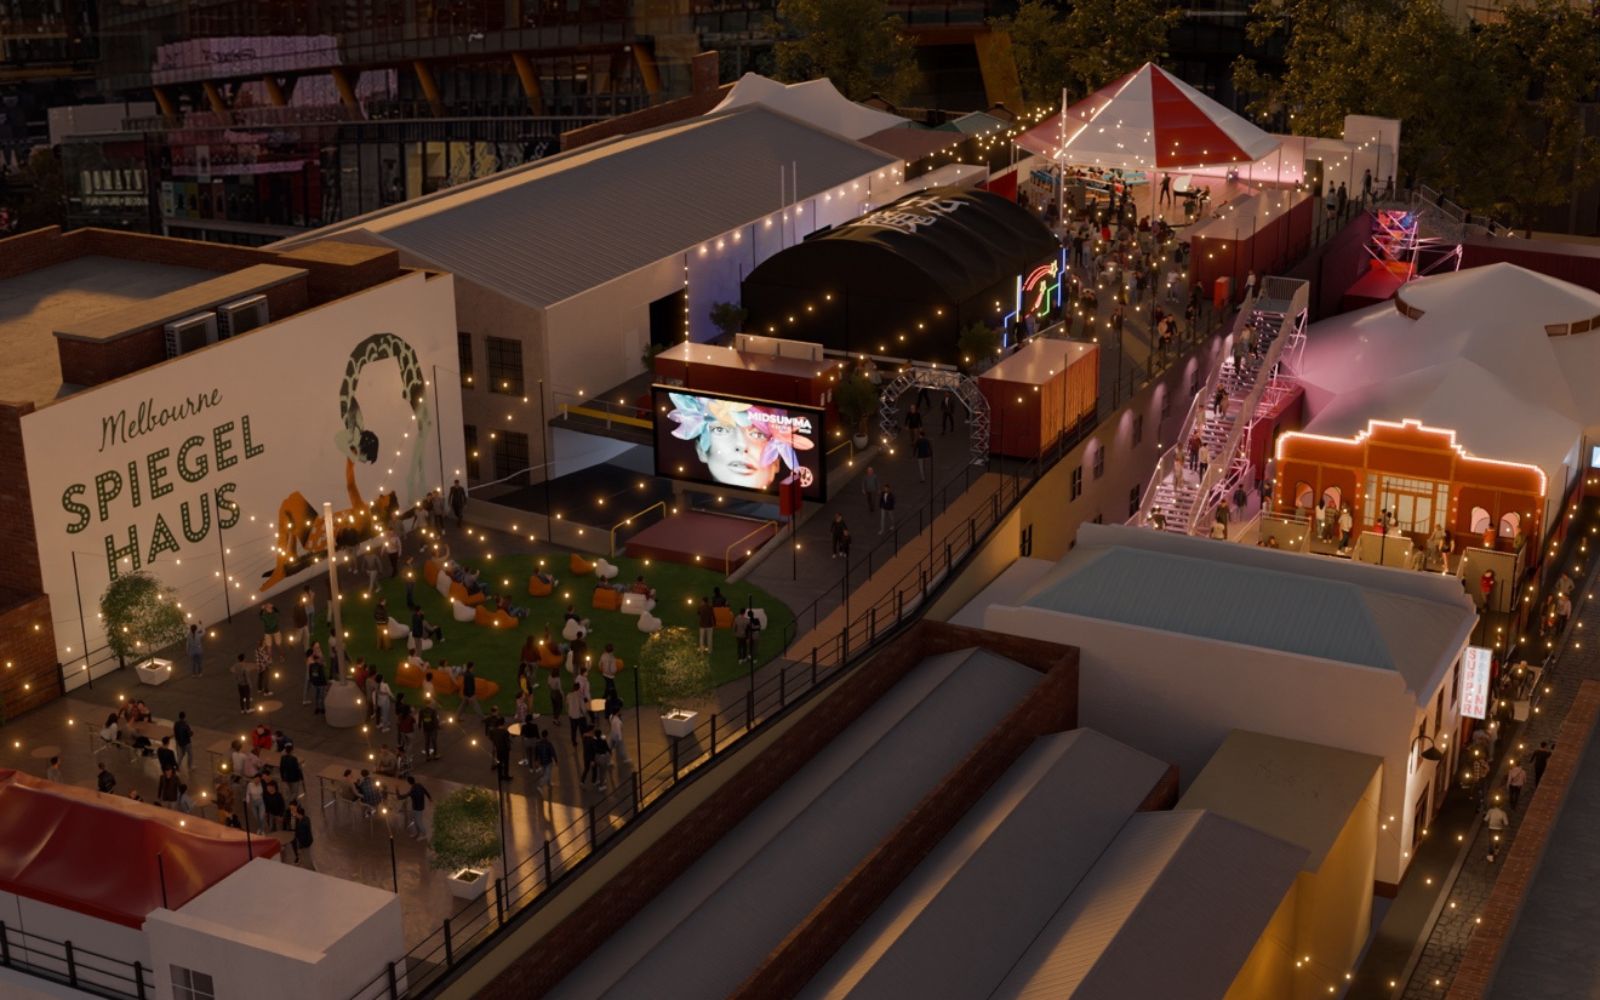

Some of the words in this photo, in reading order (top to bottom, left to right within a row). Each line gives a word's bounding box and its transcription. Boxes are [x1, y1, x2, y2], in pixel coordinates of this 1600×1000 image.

[98, 388, 222, 452] Melbourne
[747, 411, 812, 429] MIDSUMMA
[62, 415, 264, 534] SPIEGEL
[104, 483, 240, 581] HAUS
